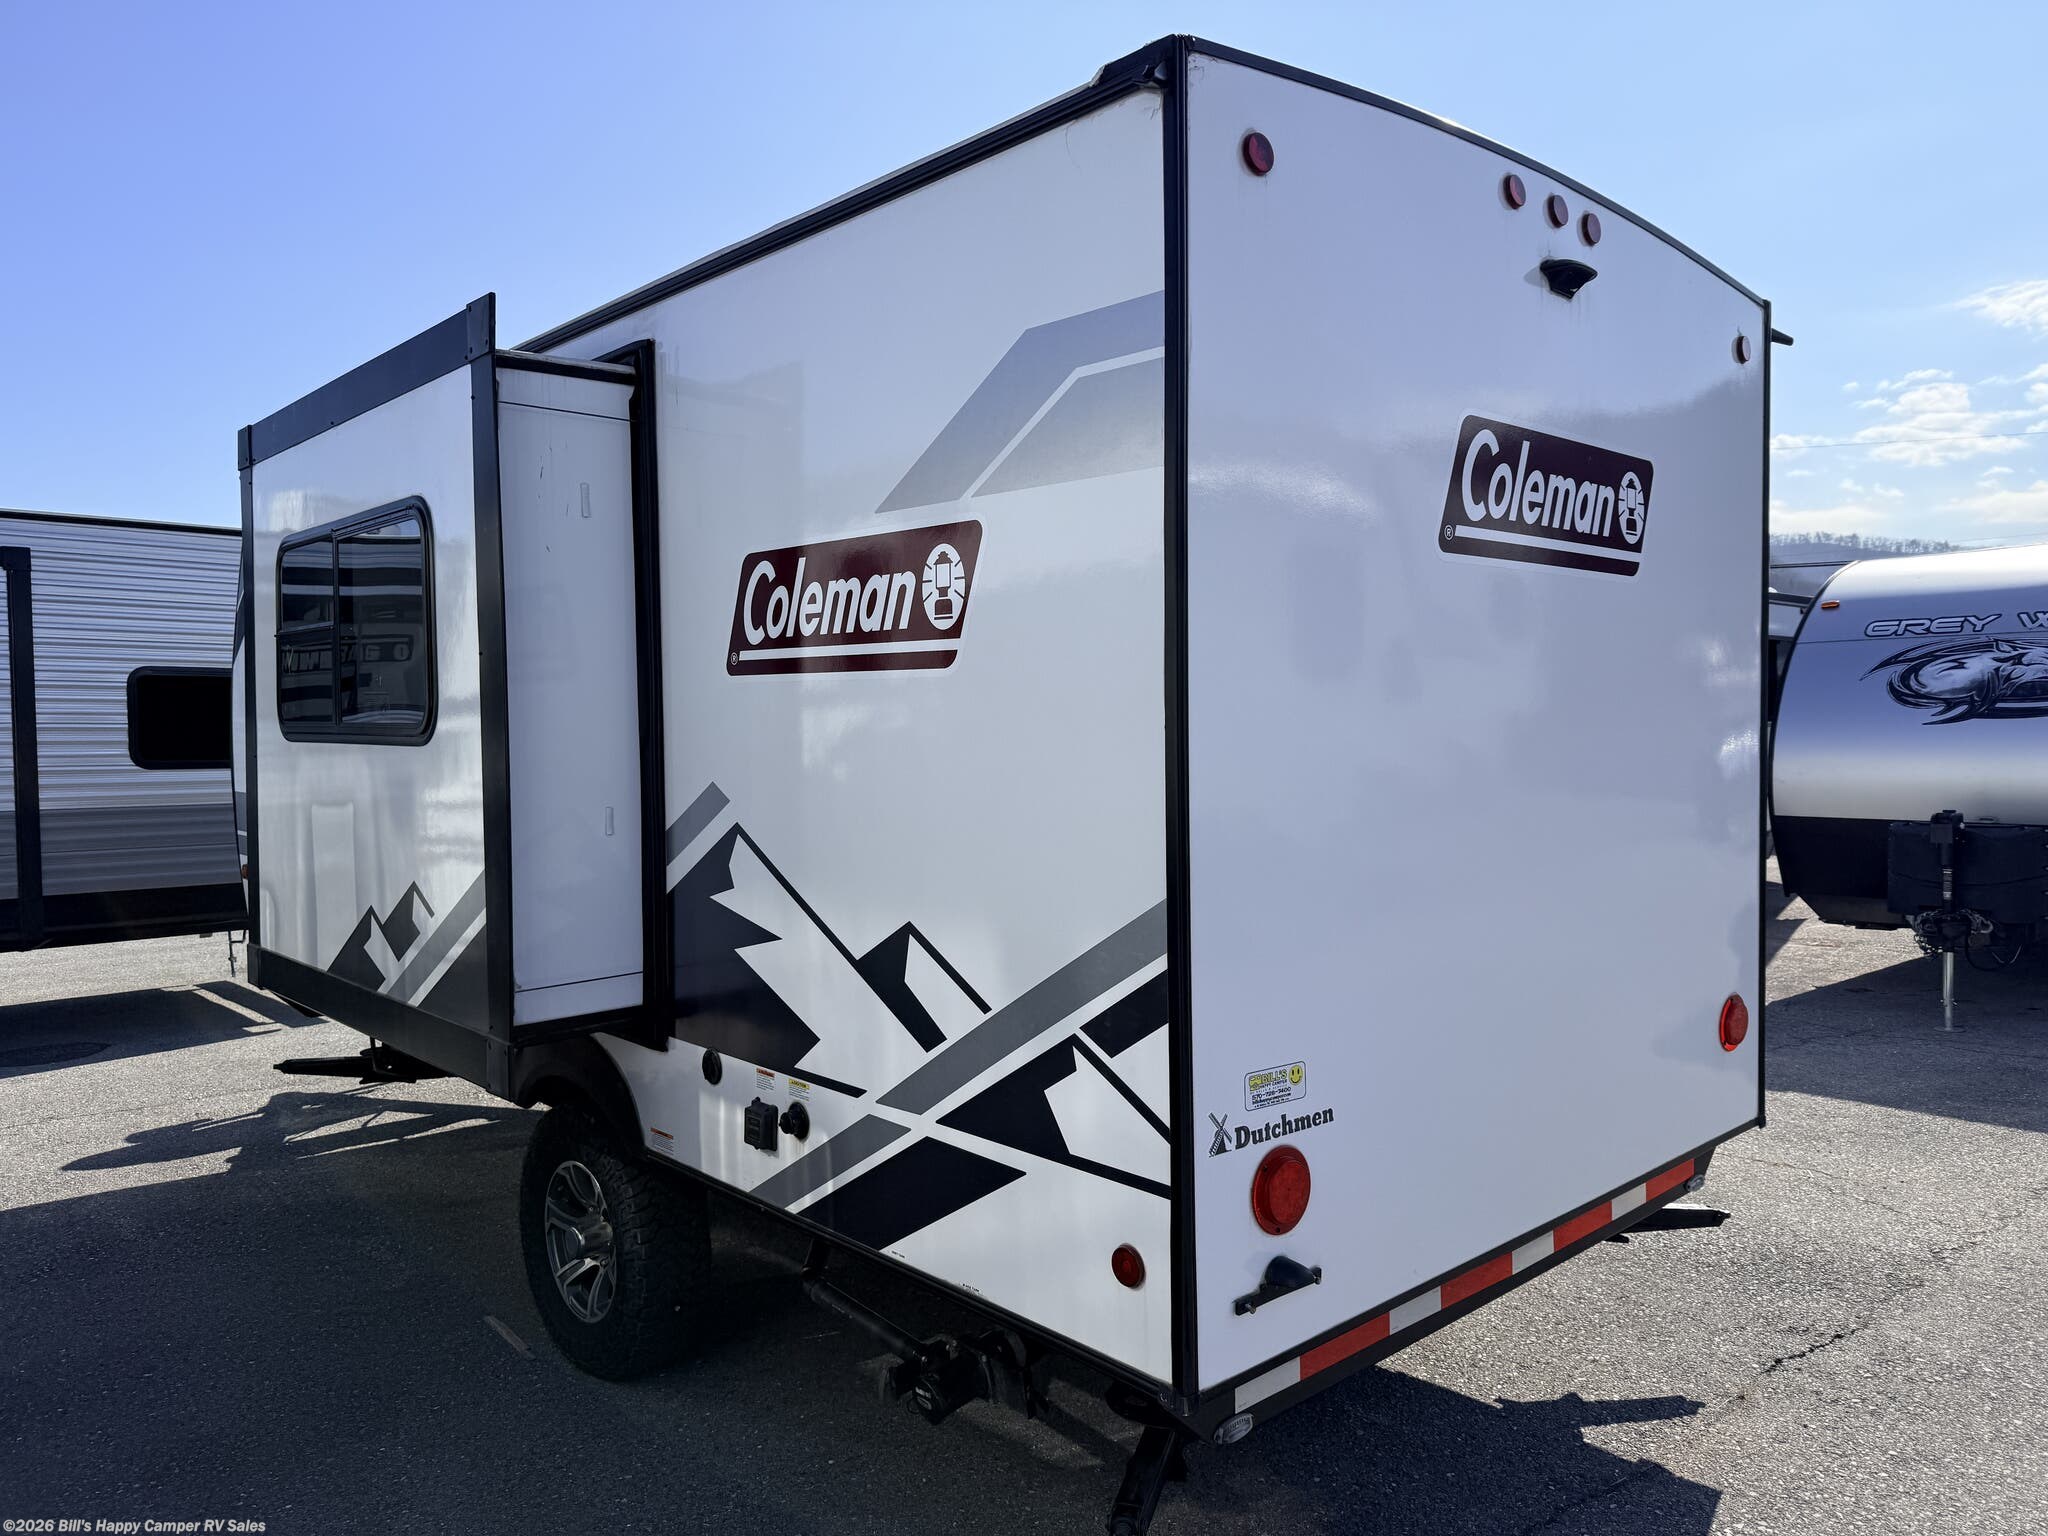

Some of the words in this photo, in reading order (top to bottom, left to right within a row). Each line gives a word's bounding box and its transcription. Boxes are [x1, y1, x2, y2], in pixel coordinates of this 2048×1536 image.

[1461, 428, 1616, 538] Coleman
[743, 556, 916, 646] Coleman
[1864, 613, 2002, 637] GREY
[1234, 1108, 1334, 1150] Dutchmen
